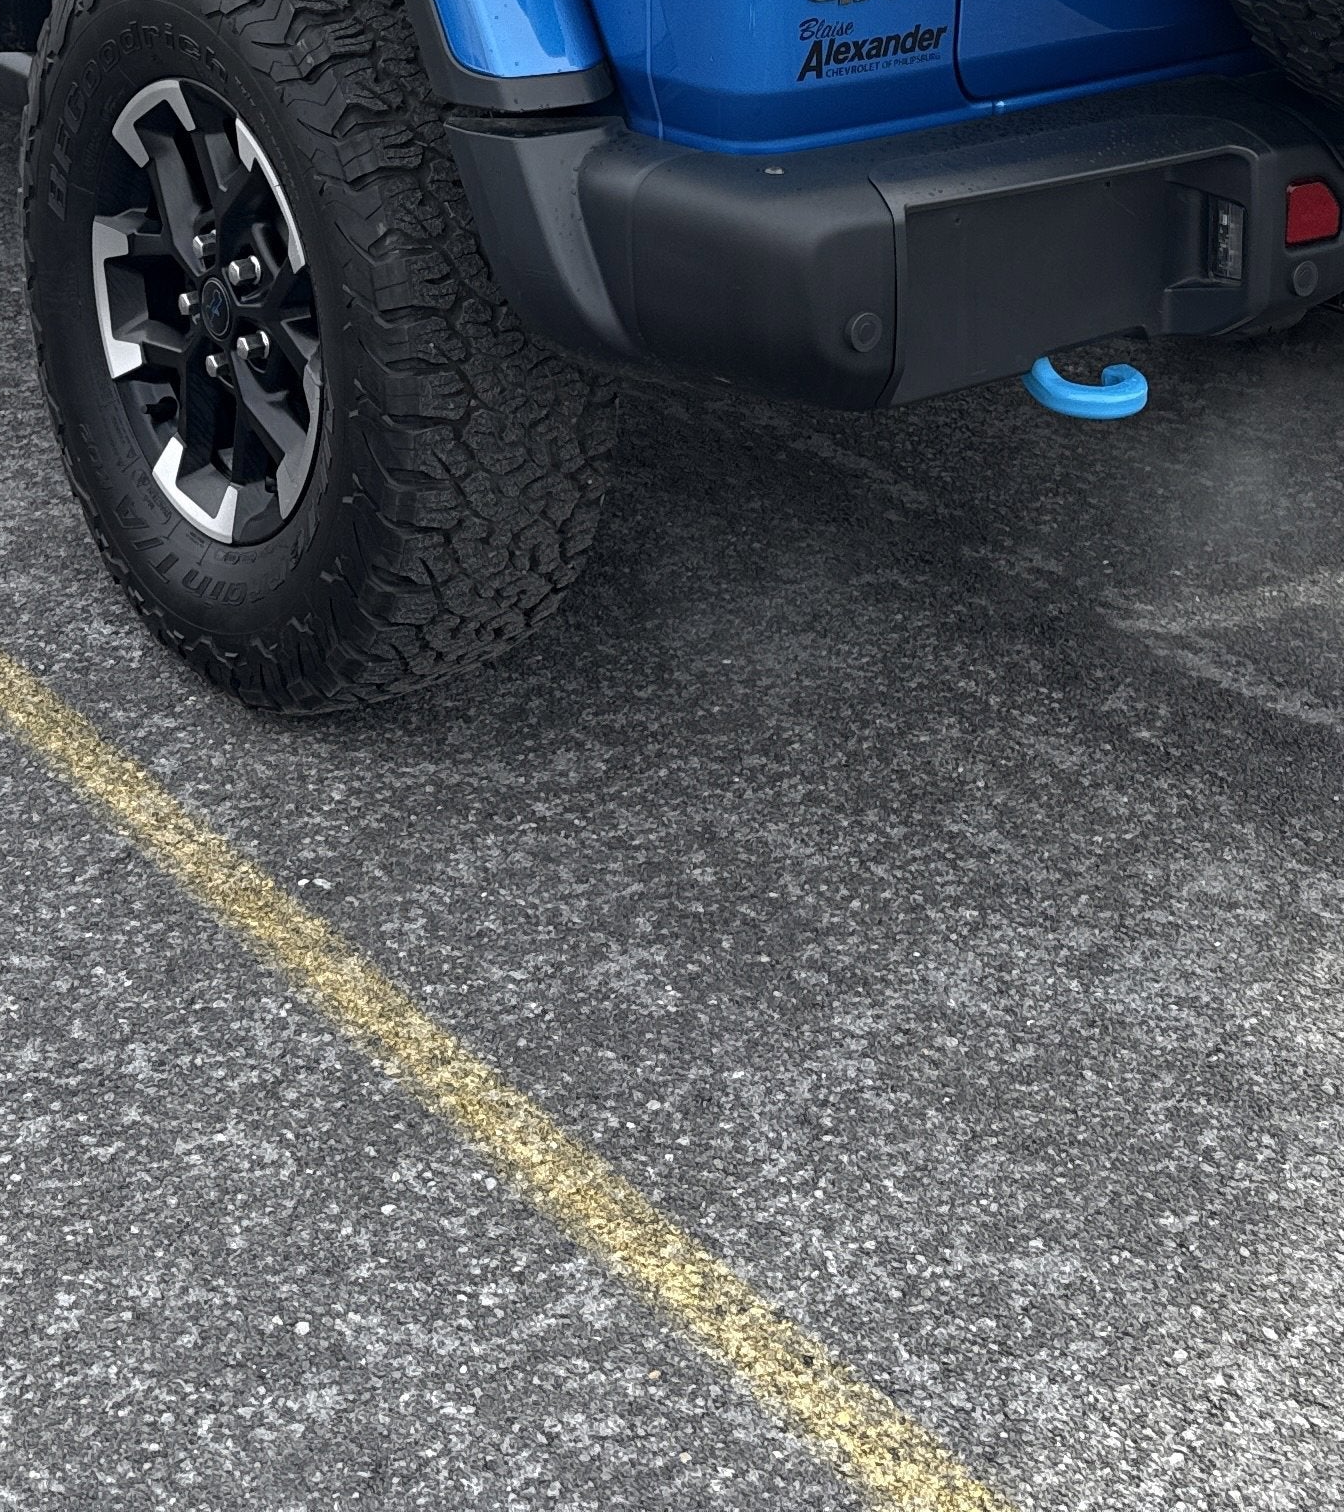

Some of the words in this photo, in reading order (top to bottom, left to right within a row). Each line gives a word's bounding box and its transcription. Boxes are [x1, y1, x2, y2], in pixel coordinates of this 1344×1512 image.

[796, 23, 948, 82] Alexander
[799, 17, 854, 41] Blaise
[825, 61, 880, 78] CHEVROLET
[882, 60, 892, 70] OF
[47, 20, 229, 223] BFGoodrich
[113, 494, 180, 584] T/A
